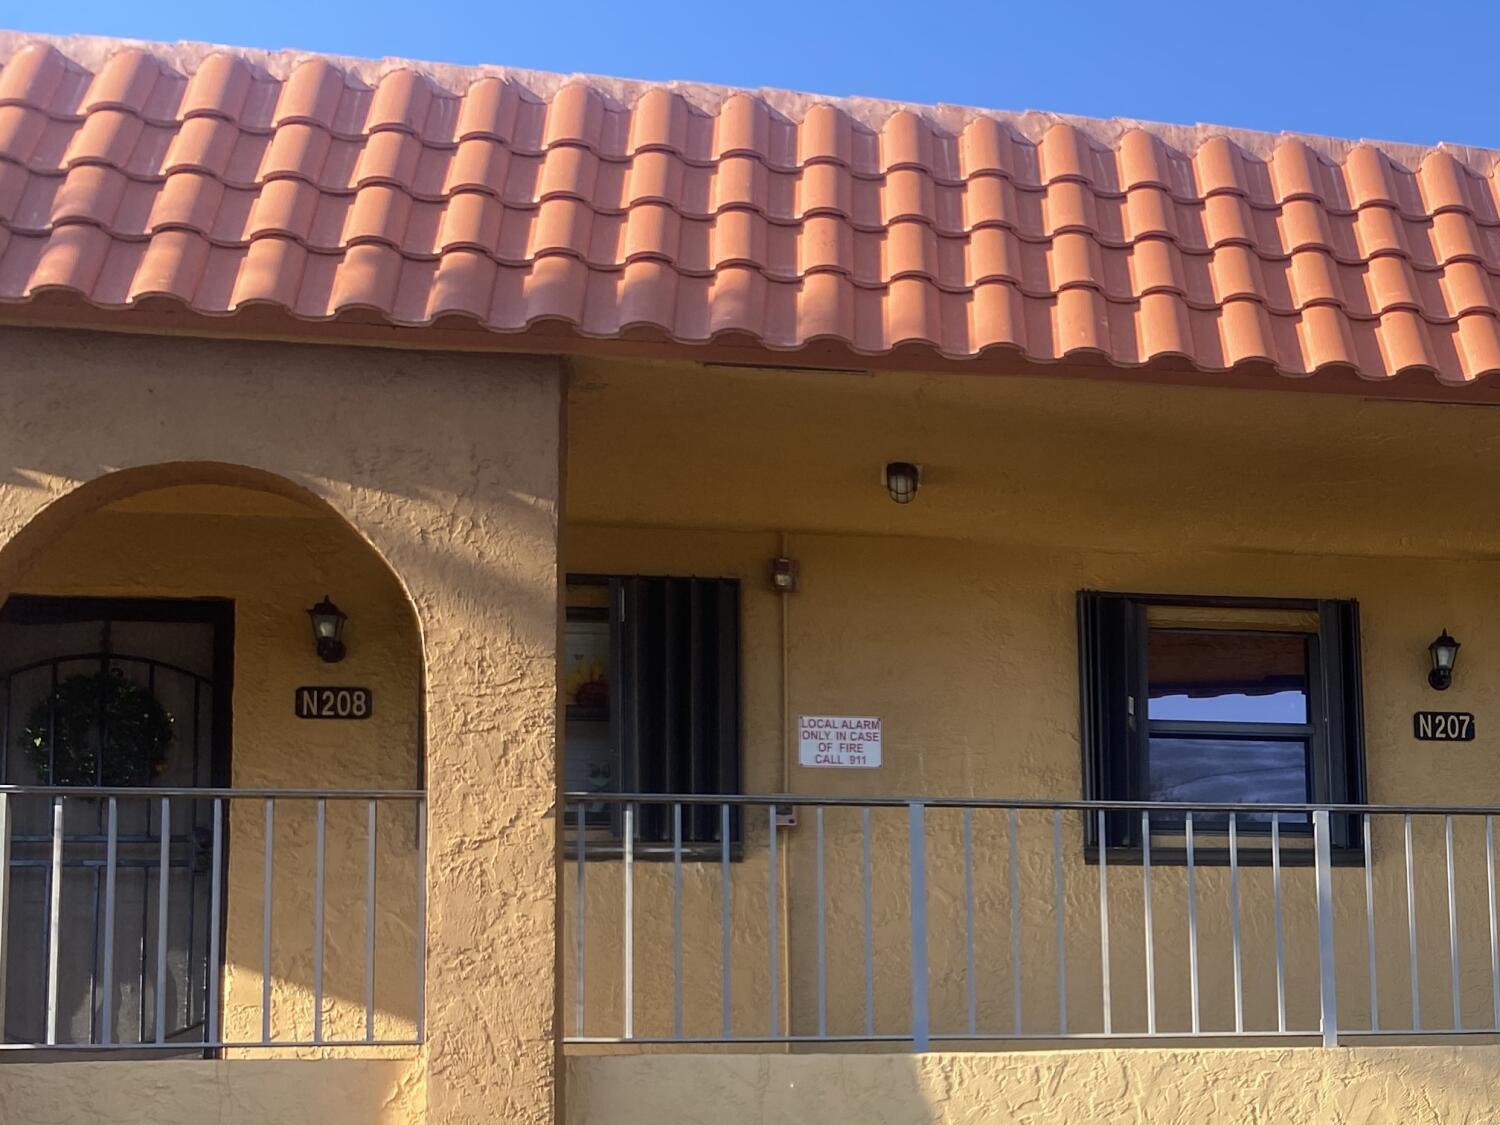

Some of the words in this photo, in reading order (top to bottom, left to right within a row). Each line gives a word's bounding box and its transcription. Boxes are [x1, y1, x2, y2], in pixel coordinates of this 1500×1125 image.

[302, 690, 366, 716] N208
[801, 718, 838, 729] LOCAL
[841, 720, 880, 730] ALARM
[1419, 714, 1470, 739] N207
[836, 731, 847, 740] IN
[850, 731, 880, 742] CASE
[818, 742, 833, 752] OF
[839, 743, 864, 753] FIRE
[815, 754, 844, 764] CALL
[849, 755, 867, 765] 911
